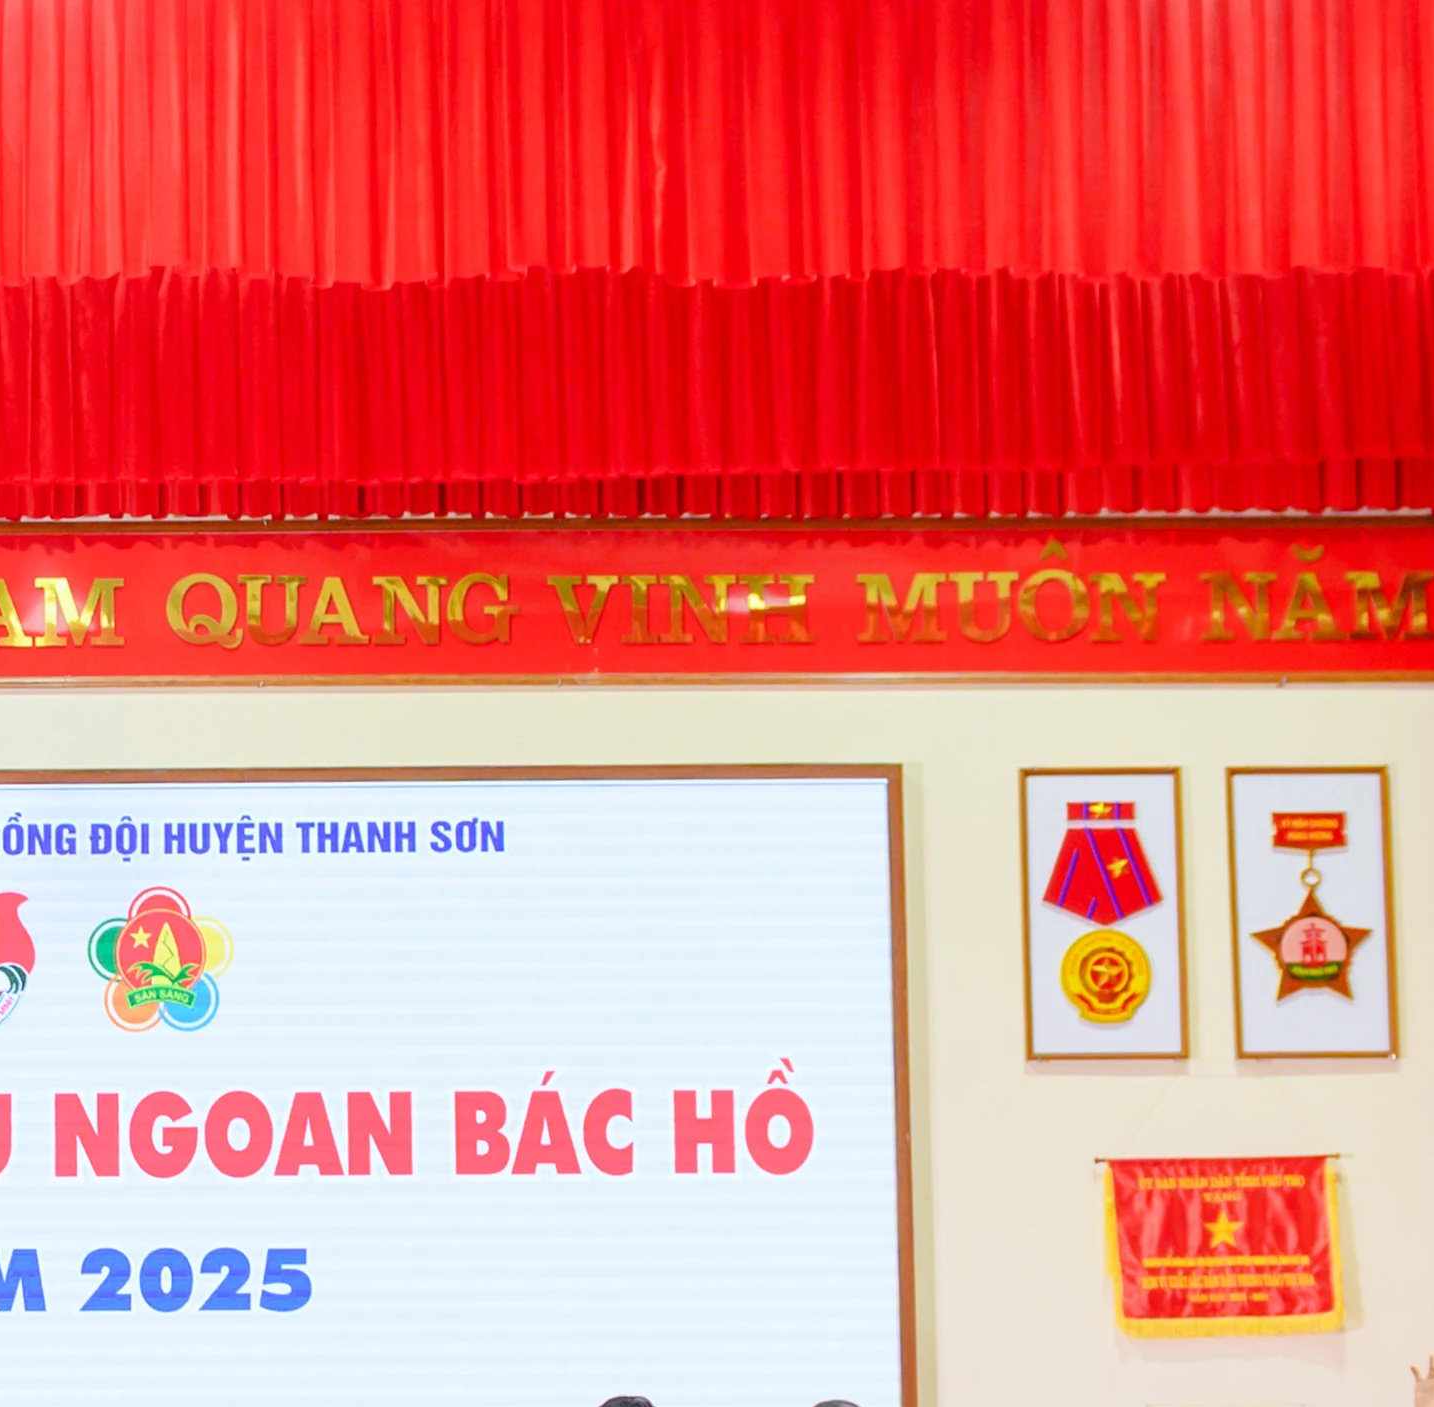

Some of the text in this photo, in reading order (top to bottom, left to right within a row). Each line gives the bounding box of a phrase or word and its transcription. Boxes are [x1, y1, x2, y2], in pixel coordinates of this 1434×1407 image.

[165, 571, 517, 651] QUANG
[549, 571, 814, 648] VINH
[856, 540, 1163, 645] MUÔN
[89, 816, 149, 861] ĐỘI
[164, 815, 283, 861] HUYỆN
[296, 822, 416, 853] THANH
[431, 818, 504, 852] SƠN
[55, 1091, 412, 1178] NGOAN
[455, 1071, 633, 1176] BÁC
[674, 1058, 813, 1175] HỒ
[80, 1248, 312, 1312] 2025
